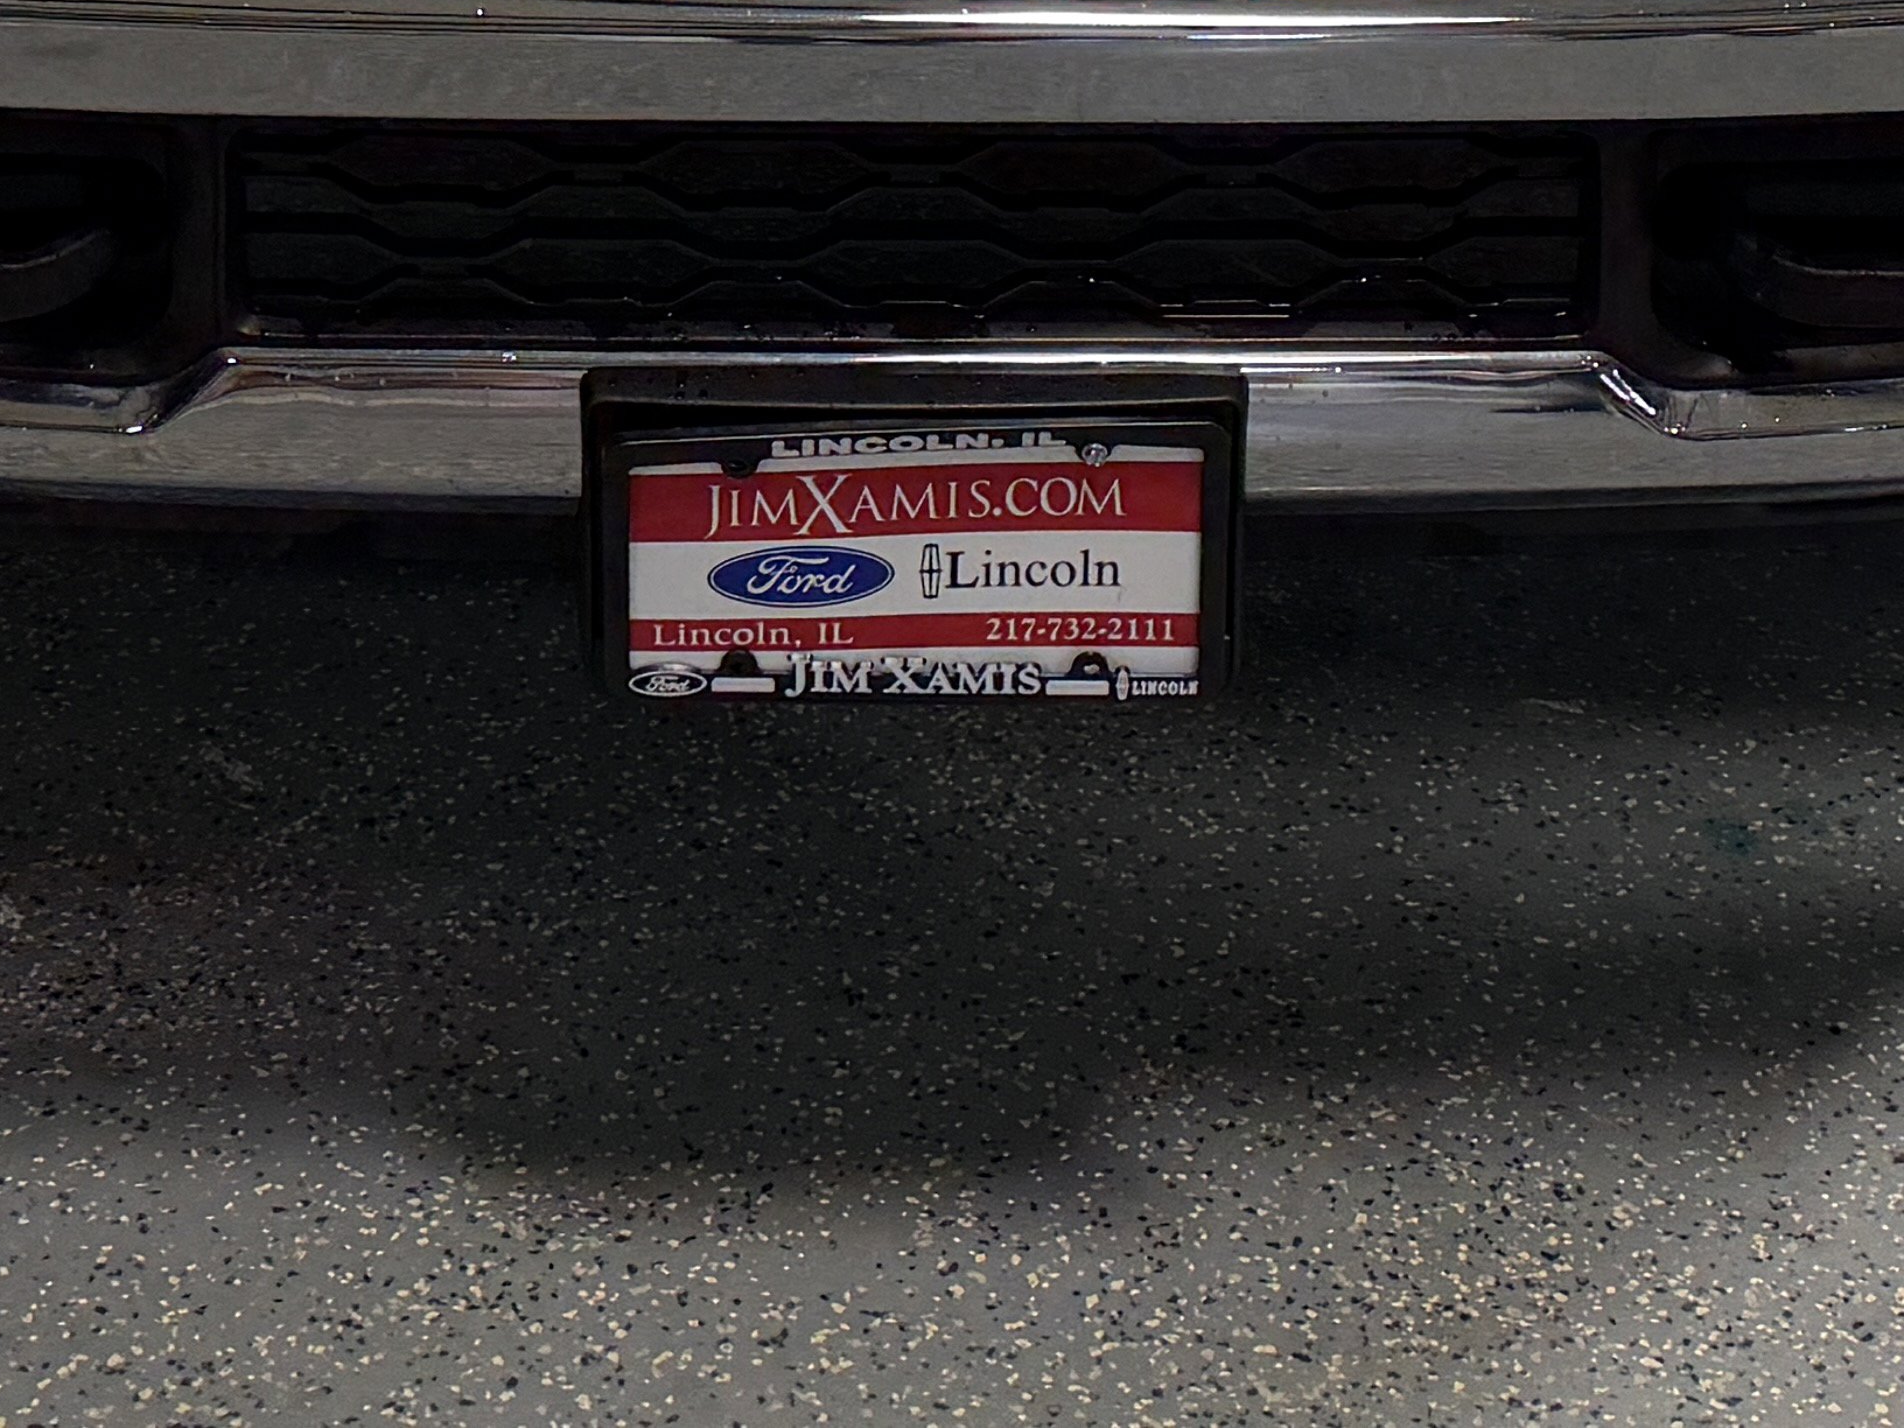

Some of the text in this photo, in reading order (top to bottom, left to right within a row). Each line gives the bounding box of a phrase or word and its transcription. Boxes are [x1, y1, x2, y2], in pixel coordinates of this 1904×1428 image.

[1021, 431, 1066, 446] IL
[704, 474, 1125, 539] JIMXAMIS.COM
[746, 555, 854, 594] Ford
[944, 549, 1121, 589] Lincoln
[653, 621, 854, 649] Lincoln, IL
[985, 617, 1175, 642] 217-732-2111
[784, 652, 1042, 698] JIM XAMIS
[1131, 680, 1198, 697] LINCOLN
